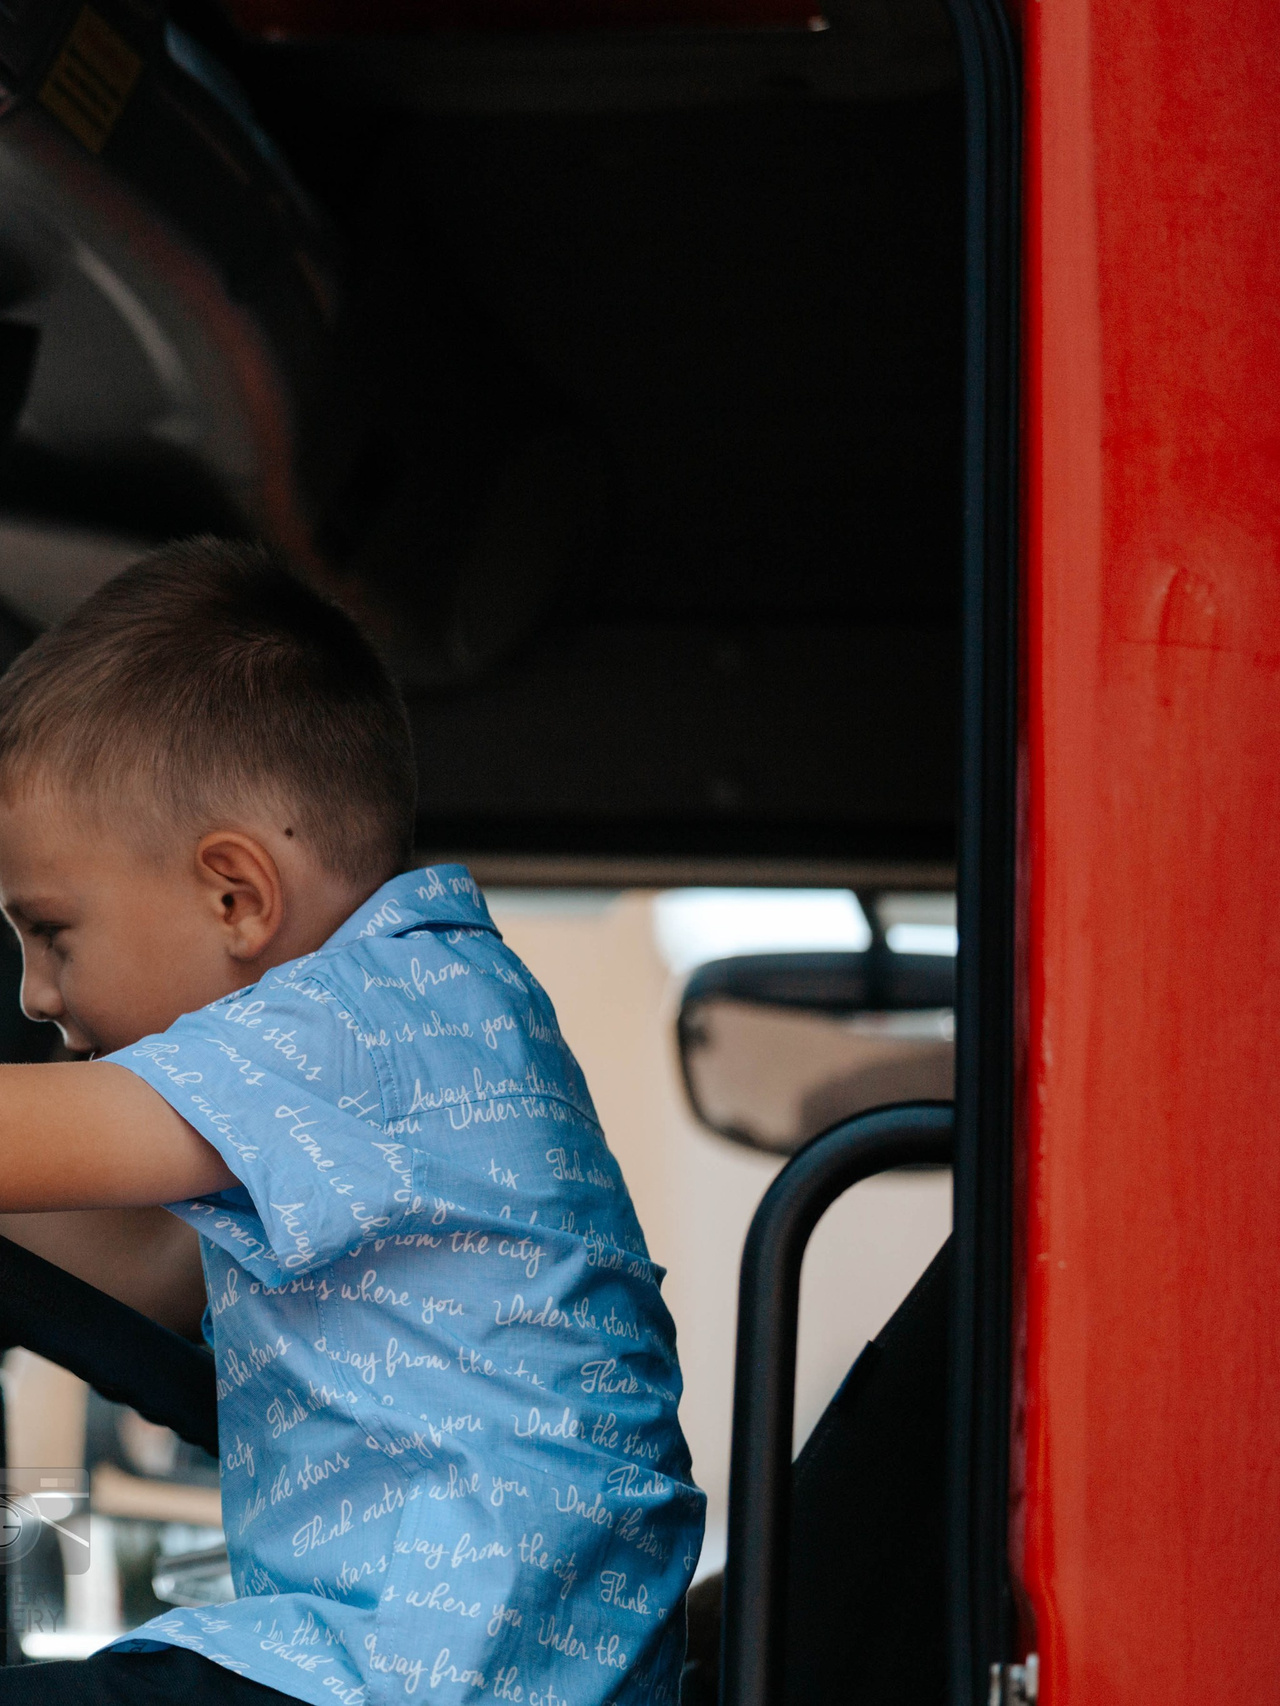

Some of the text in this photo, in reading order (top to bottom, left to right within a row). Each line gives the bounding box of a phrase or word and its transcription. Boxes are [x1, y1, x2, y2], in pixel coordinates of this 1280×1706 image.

[411, 957, 470, 996] from
[224, 1000, 323, 1081] the stars
[395, 1020, 418, 1044] is
[422, 1010, 474, 1039] where
[480, 1013, 518, 1049] you
[132, 1042, 261, 1164] Think outside
[472, 1067, 524, 1100] from
[444, 1099, 521, 1131] Under
[275, 1104, 336, 1173] Home
[329, 1173, 356, 1197] is
[270, 1202, 317, 1268] Away
[450, 1229, 490, 1255] the
[498, 1236, 547, 1279] city
[341, 1269, 412, 1307] where
[422, 1296, 465, 1324] you
[493, 1293, 573, 1327] Under
[572, 1296, 601, 1331] the
[224, 1348, 251, 1387] the
[250, 1335, 292, 1372] stars
[385, 1337, 451, 1378] from
[458, 1346, 496, 1376] the
[580, 1358, 640, 1394] Think
[266, 1388, 309, 1439] Think
[511, 1407, 587, 1439] Under
[226, 1434, 255, 1478] city
[269, 1464, 294, 1506] the
[297, 1452, 351, 1491] stars
[291, 1498, 355, 1558] Think
[429, 1463, 482, 1501] where
[490, 1475, 529, 1507] you
[551, 1484, 614, 1529] Under
[450, 1533, 512, 1569] from
[517, 1532, 550, 1569] the
[600, 1569, 651, 1615] Think
[291, 1611, 321, 1647] the
[406, 1582, 482, 1619] where
[486, 1602, 522, 1637] you
[538, 1615, 590, 1660] Under
[593, 1634, 628, 1671] the
[430, 1647, 489, 1689] from
[493, 1666, 524, 1703] the
